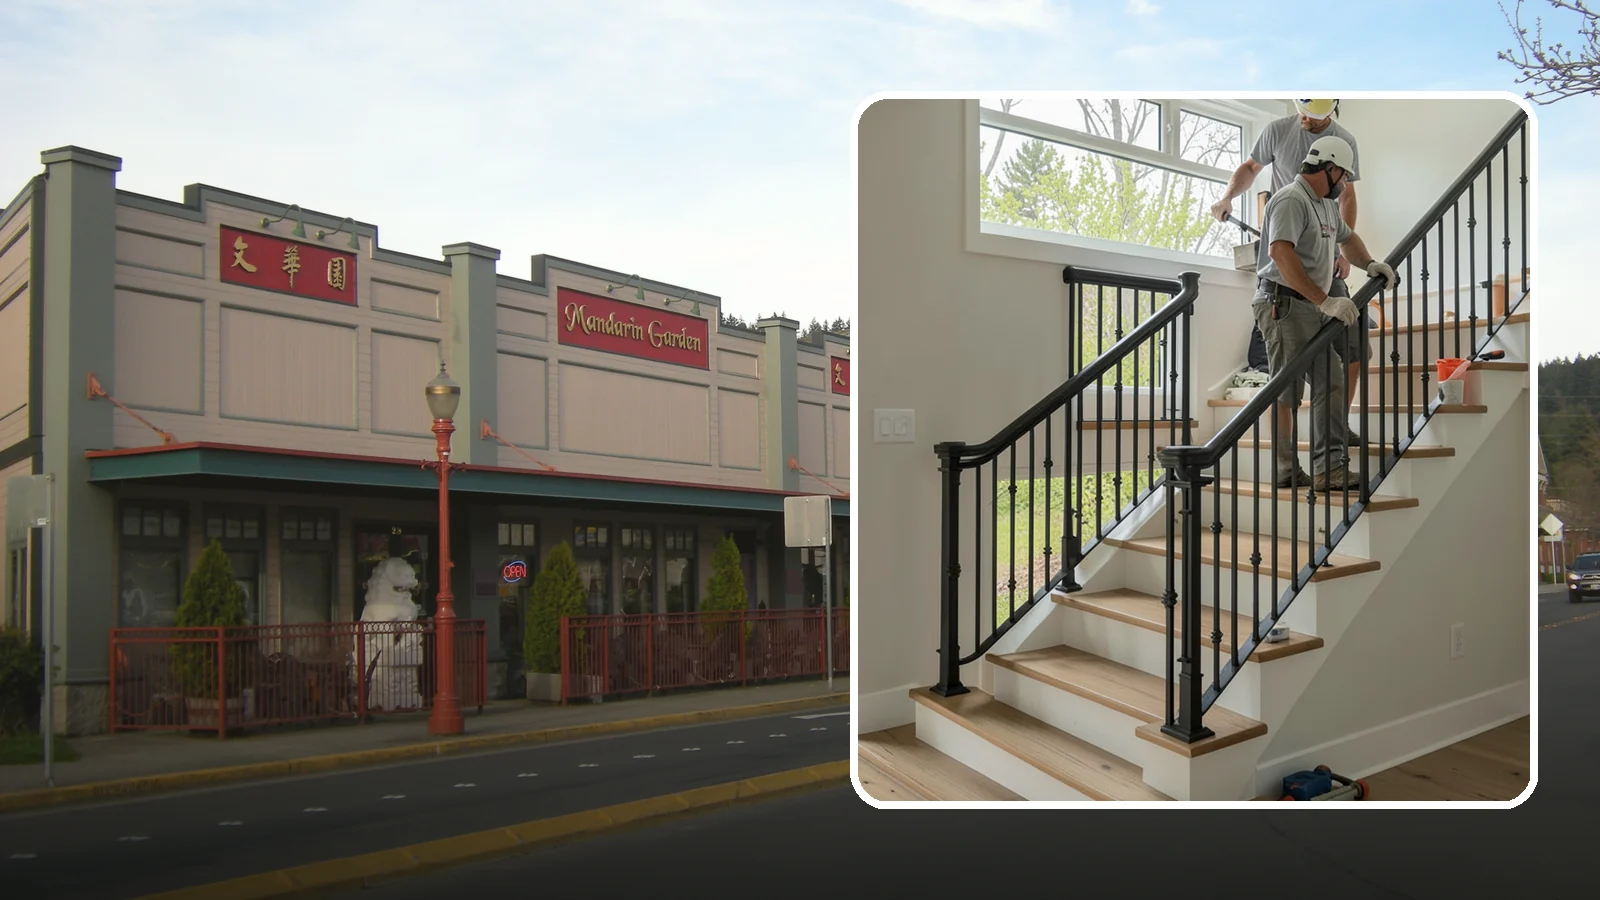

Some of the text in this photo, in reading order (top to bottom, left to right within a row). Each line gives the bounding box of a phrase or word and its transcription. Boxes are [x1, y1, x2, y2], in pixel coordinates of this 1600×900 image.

[231, 236, 346, 290] 文華園
[564, 302, 702, 352] Mandarin Garden
[503, 565, 527, 578] OPEN
